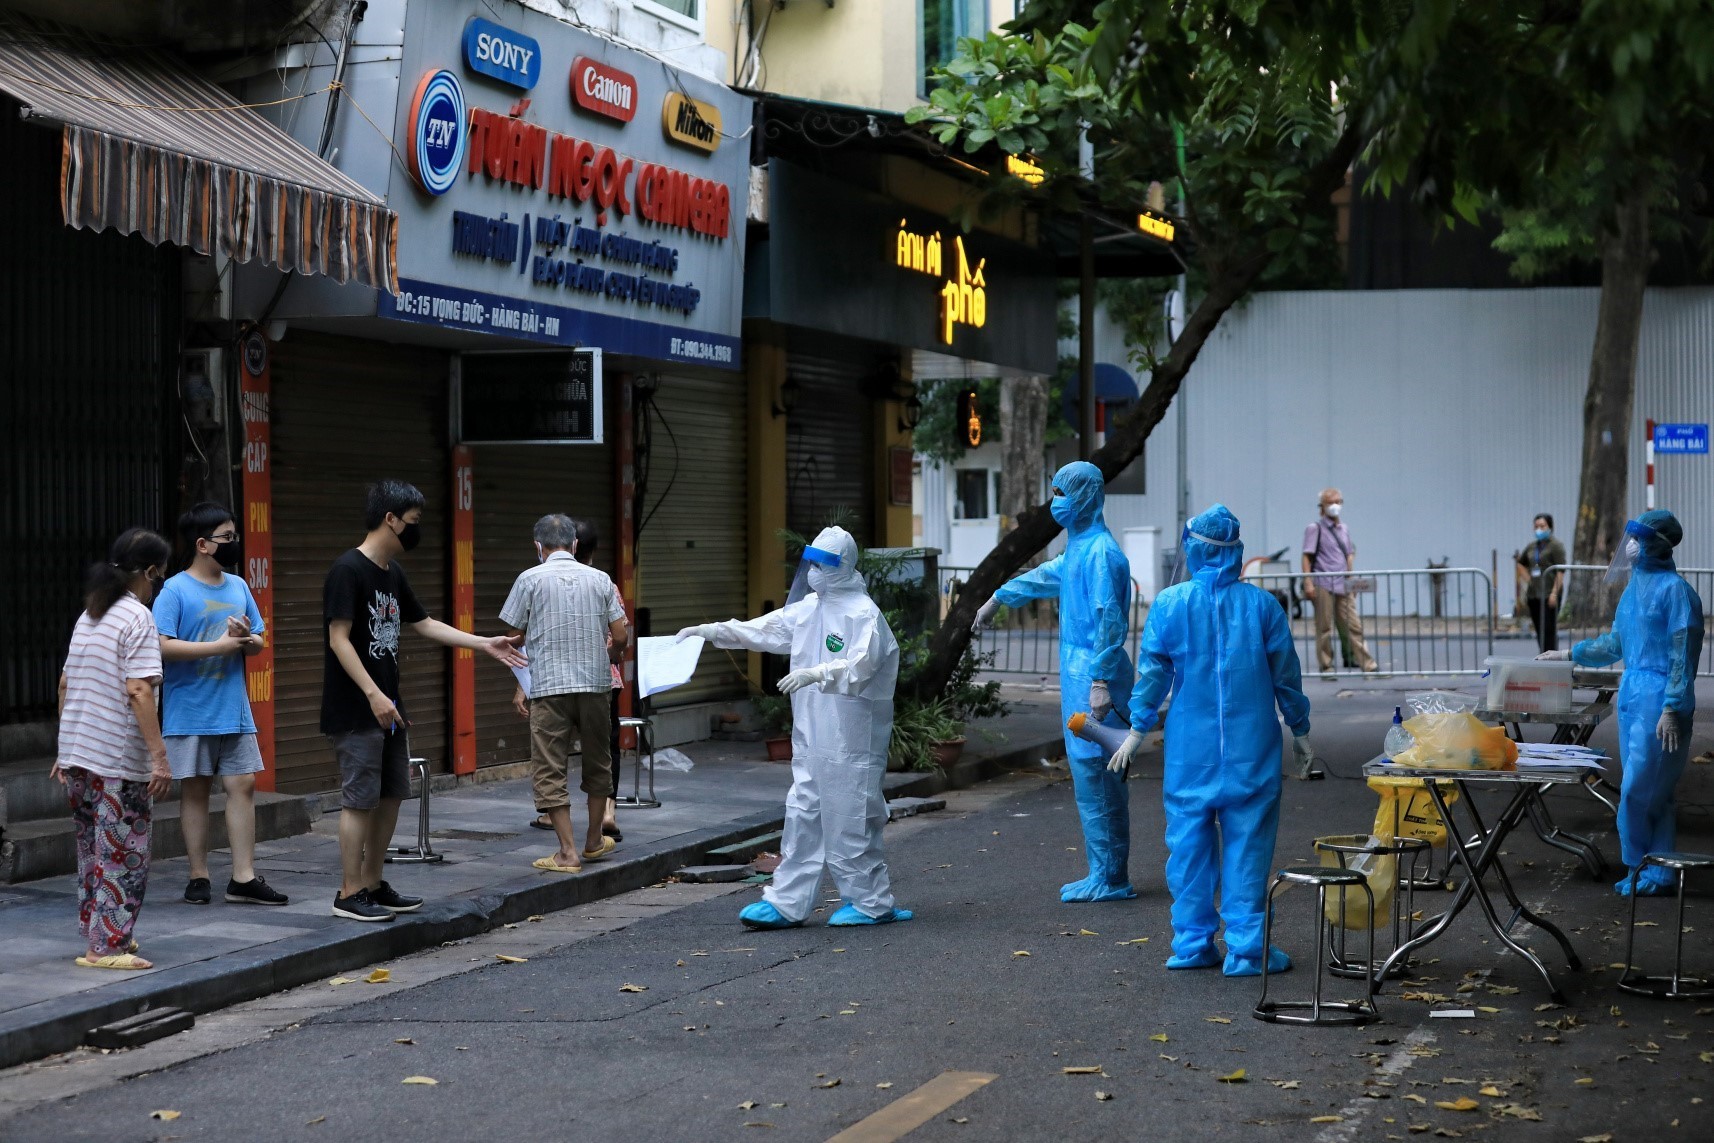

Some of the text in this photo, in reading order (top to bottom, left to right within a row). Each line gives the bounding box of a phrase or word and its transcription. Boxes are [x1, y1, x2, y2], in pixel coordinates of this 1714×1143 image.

[476, 33, 533, 76] SONY
[583, 66, 632, 110] Canon
[426, 118, 456, 149] TN
[675, 101, 715, 143] Nikon
[469, 99, 730, 239] TUẤN NGỌC CAMERA
[432, 297, 460, 323] VỌNG
[462, 298, 485, 325] ĐỨC
[491, 303, 521, 330] HÀNG
[521, 308, 539, 334] BÀI
[544, 317, 560, 337] HN
[457, 466, 472, 511] 15
[250, 502, 268, 533] PIN
[250, 557, 268, 594] SẠC
[249, 661, 271, 702] NHỚ
